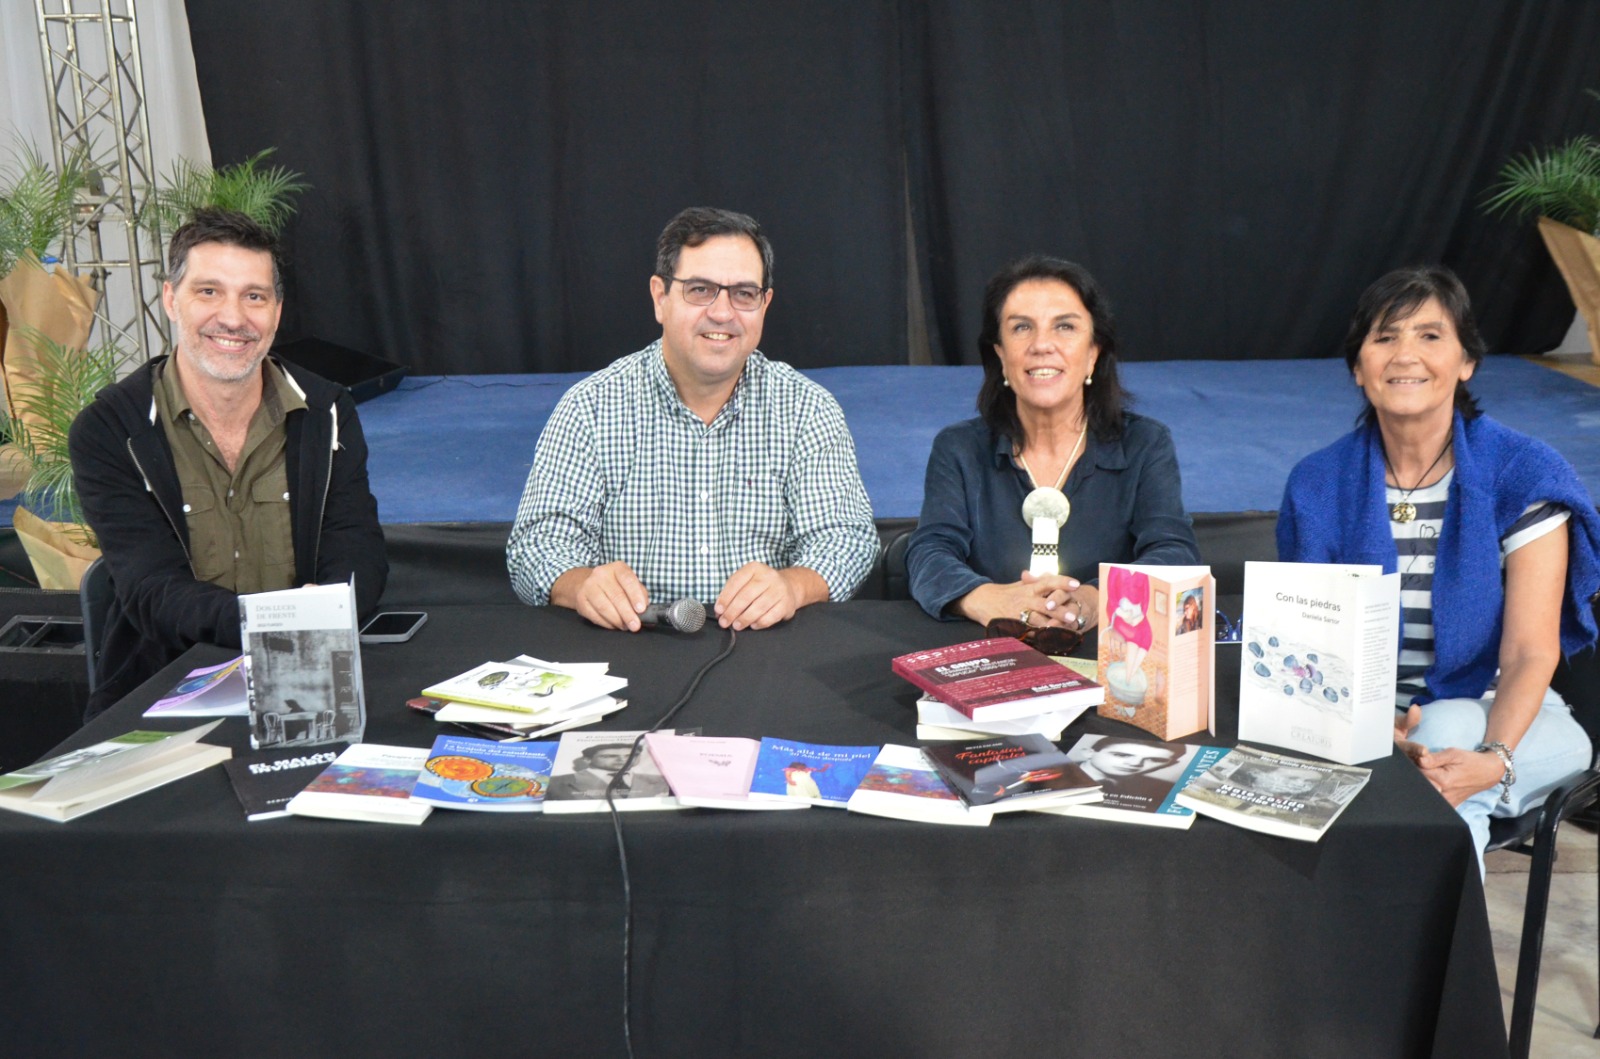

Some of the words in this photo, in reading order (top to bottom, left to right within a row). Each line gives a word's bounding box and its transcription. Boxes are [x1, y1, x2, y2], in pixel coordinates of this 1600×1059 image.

[1275, 592, 1294, 603] Con
[1296, 595, 1308, 605] las
[1310, 598, 1341, 611] piedras
[1302, 612, 1323, 621] Daniela
[950, 658, 990, 668] GRUPO
[273, 751, 337, 768] MALÓN
[968, 752, 1027, 765] capitales
[1194, 750, 1220, 773] ANTES
[1220, 784, 1254, 796] Mate
[1230, 792, 1268, 805] escribe
[1271, 802, 1290, 810] con
